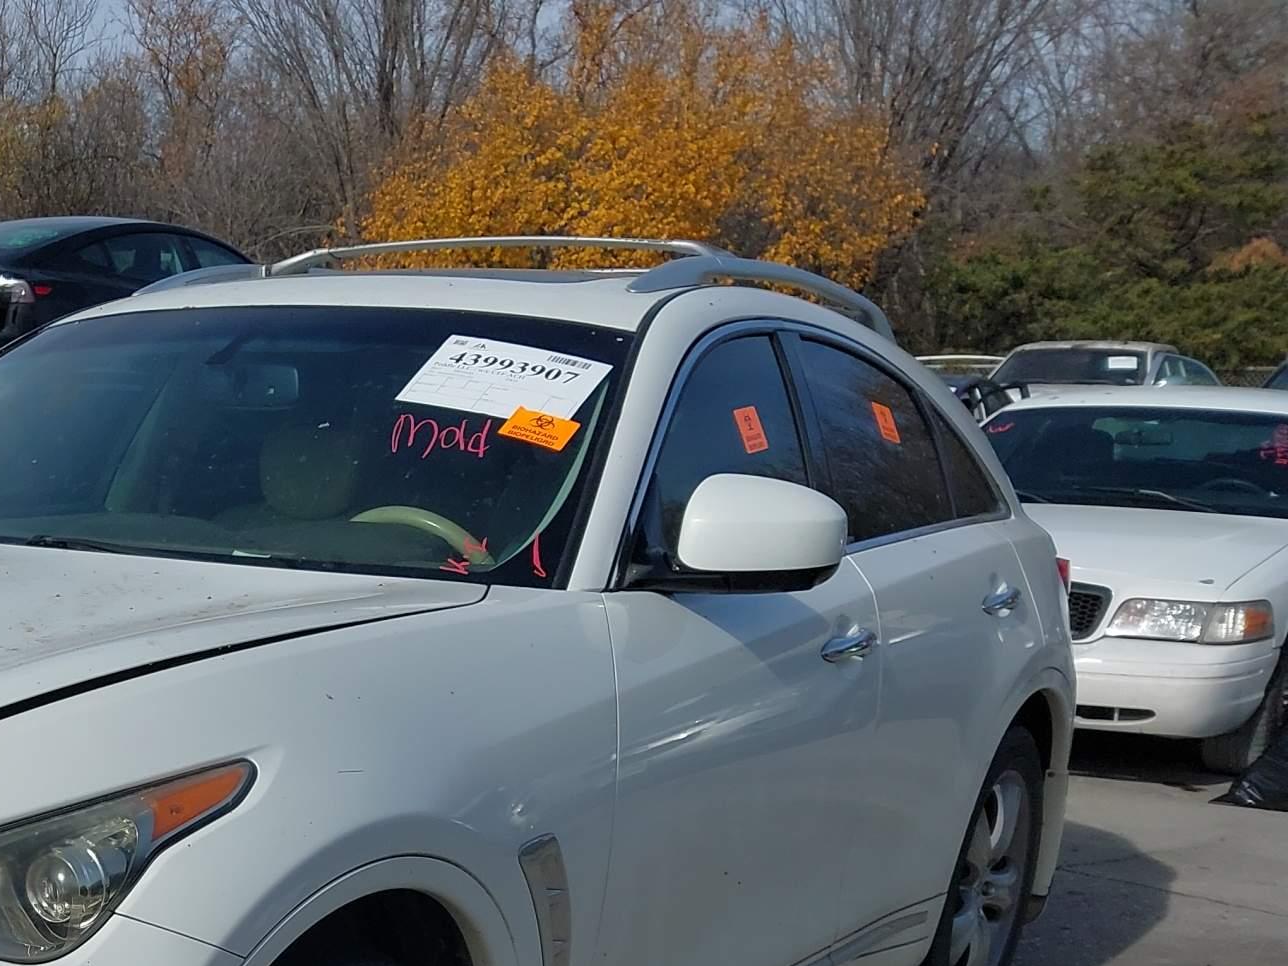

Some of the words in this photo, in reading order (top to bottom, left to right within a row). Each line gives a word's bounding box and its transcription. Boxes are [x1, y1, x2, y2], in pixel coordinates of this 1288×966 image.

[449, 352, 580, 384] 43993907
[392, 414, 492, 458] Mold
[512, 425, 559, 442] BIOHAZARD
